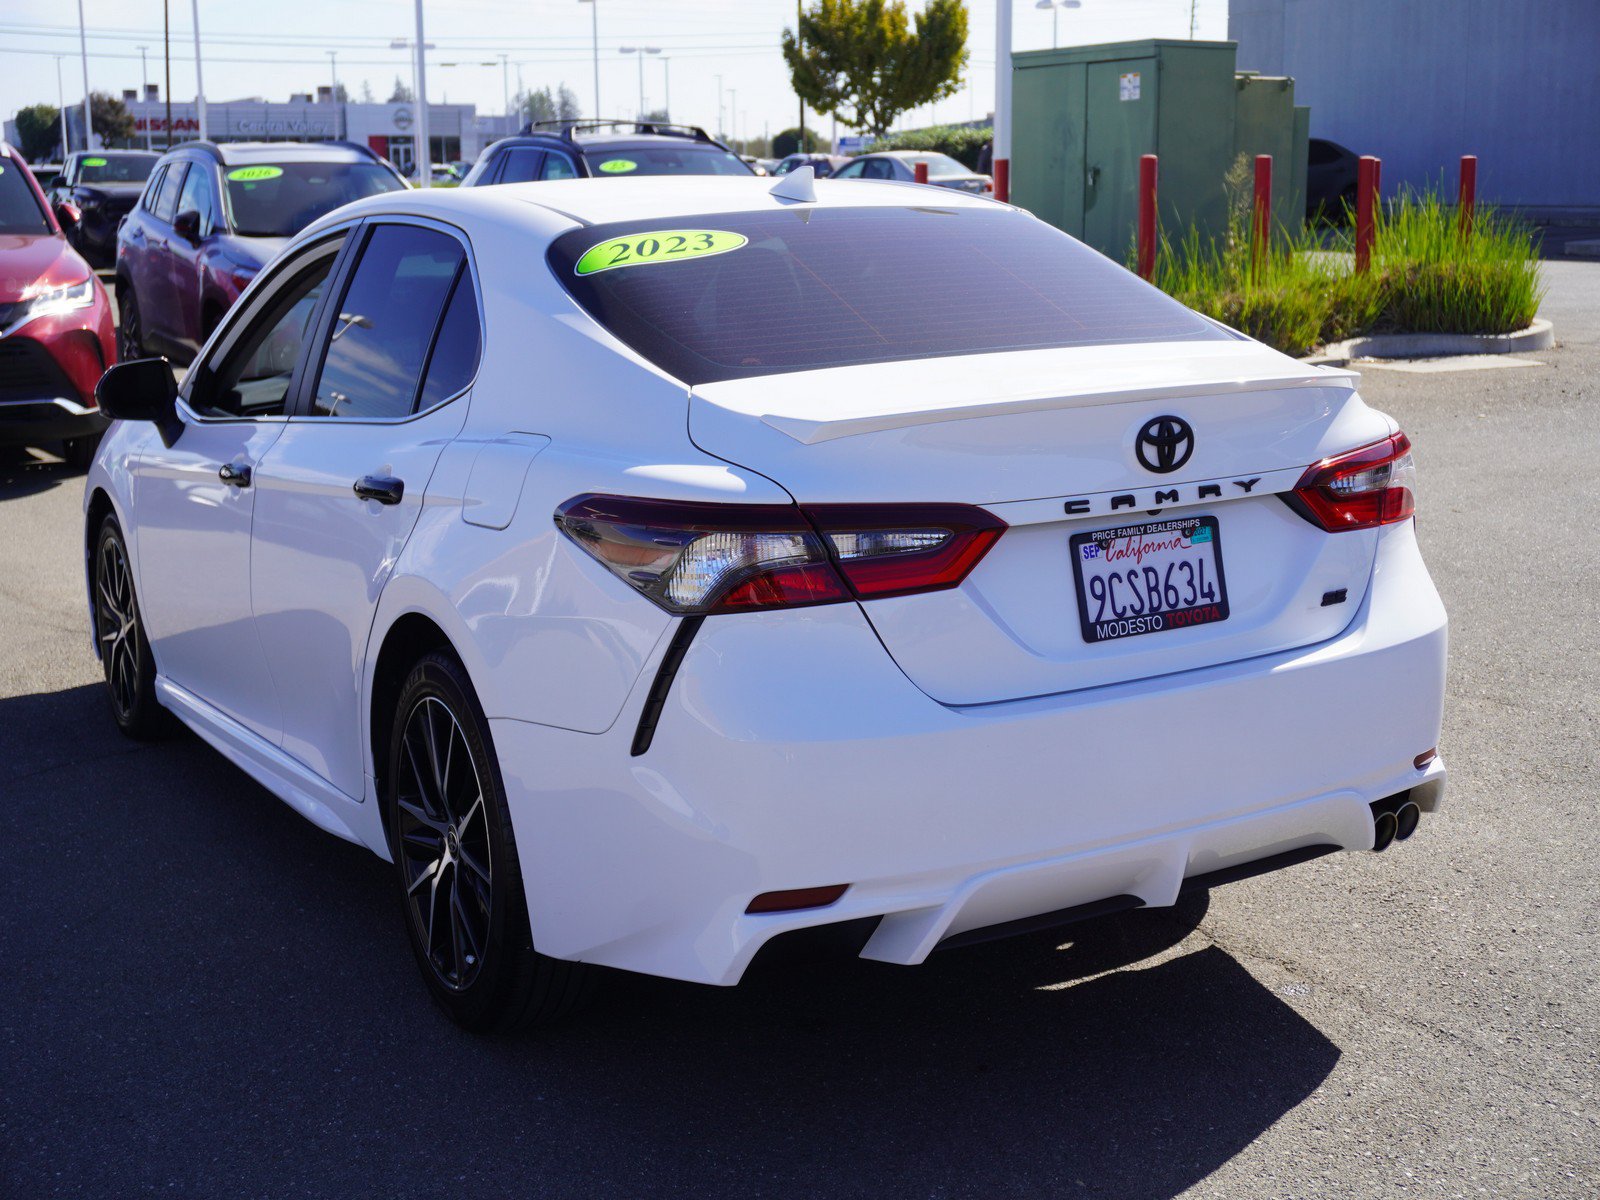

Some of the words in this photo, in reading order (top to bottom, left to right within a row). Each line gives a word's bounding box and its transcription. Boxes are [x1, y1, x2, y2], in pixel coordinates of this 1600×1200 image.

[134, 117, 200, 131] NISSAN
[237, 119, 285, 133] Central
[287, 119, 328, 134] Valley
[608, 233, 714, 265] 2023
[1064, 477, 1262, 515] CAMRY
[1092, 528, 1116, 541] PRICE
[1117, 525, 1145, 538] FAMILY
[1146, 518, 1201, 534] DEALERSHIPS
[1083, 544, 1100, 560] SEP
[1105, 535, 1192, 564] California
[1089, 558, 1216, 623] 9CSB634
[1096, 615, 1163, 639] MODESTO
[1165, 606, 1221, 628] TOYOTA
